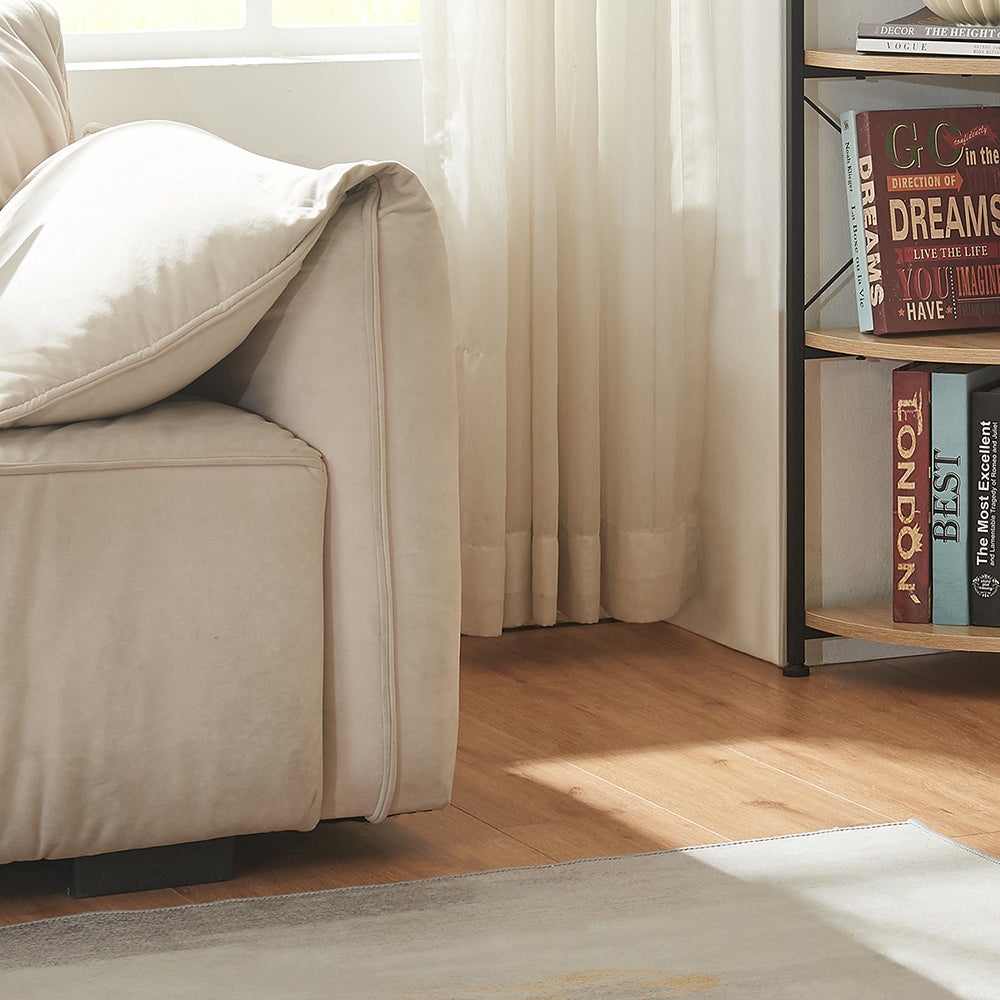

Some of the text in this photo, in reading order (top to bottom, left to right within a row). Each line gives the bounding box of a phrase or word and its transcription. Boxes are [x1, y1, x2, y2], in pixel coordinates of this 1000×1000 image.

[880, 27, 915, 36] DECOR
[925, 27, 948, 37] THE
[950, 29, 996, 38] HEIGHT
[886, 42, 928, 51] VOGUE
[964, 146, 1000, 166] in the
[892, 174, 956, 189] DIRECTION OF
[859, 154, 885, 308] DREAMS
[914, 245, 988, 260] LIVE THE LIFE
[896, 264, 950, 300] YOU
[906, 301, 945, 321] HAVE
[978, 420, 991, 491] Excellent
[933, 447, 962, 544] BEST
[990, 486, 998, 514] Tragedy
[977, 495, 990, 533] Most
[976, 536, 989, 566] The
